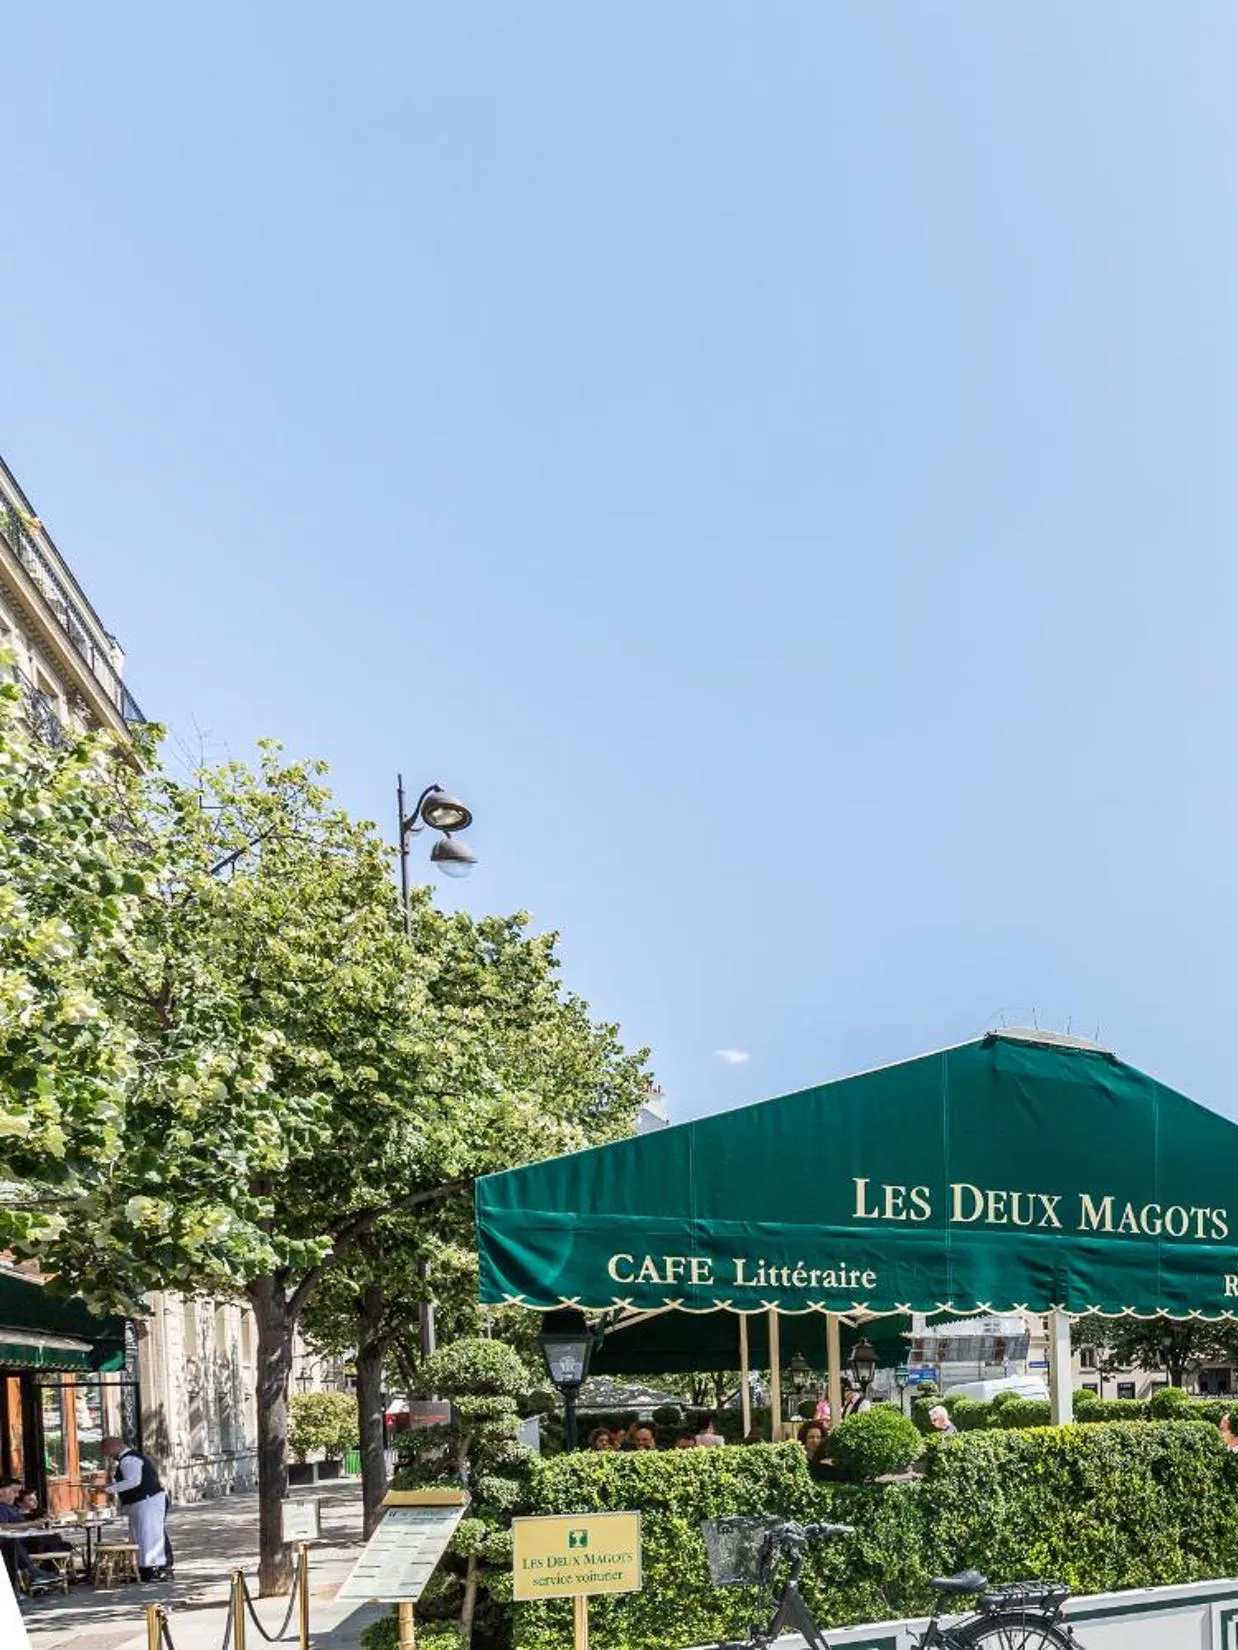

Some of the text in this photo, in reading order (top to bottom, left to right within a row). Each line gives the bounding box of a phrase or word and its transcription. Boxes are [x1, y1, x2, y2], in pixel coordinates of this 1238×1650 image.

[852, 1177, 1229, 1240] LES DEUX MAGOTS
[607, 1253, 877, 1289] CAFE Littéraire
[522, 1552, 633, 1569] LES DEUX MAGOTS
[532, 1572, 572, 1587] service
